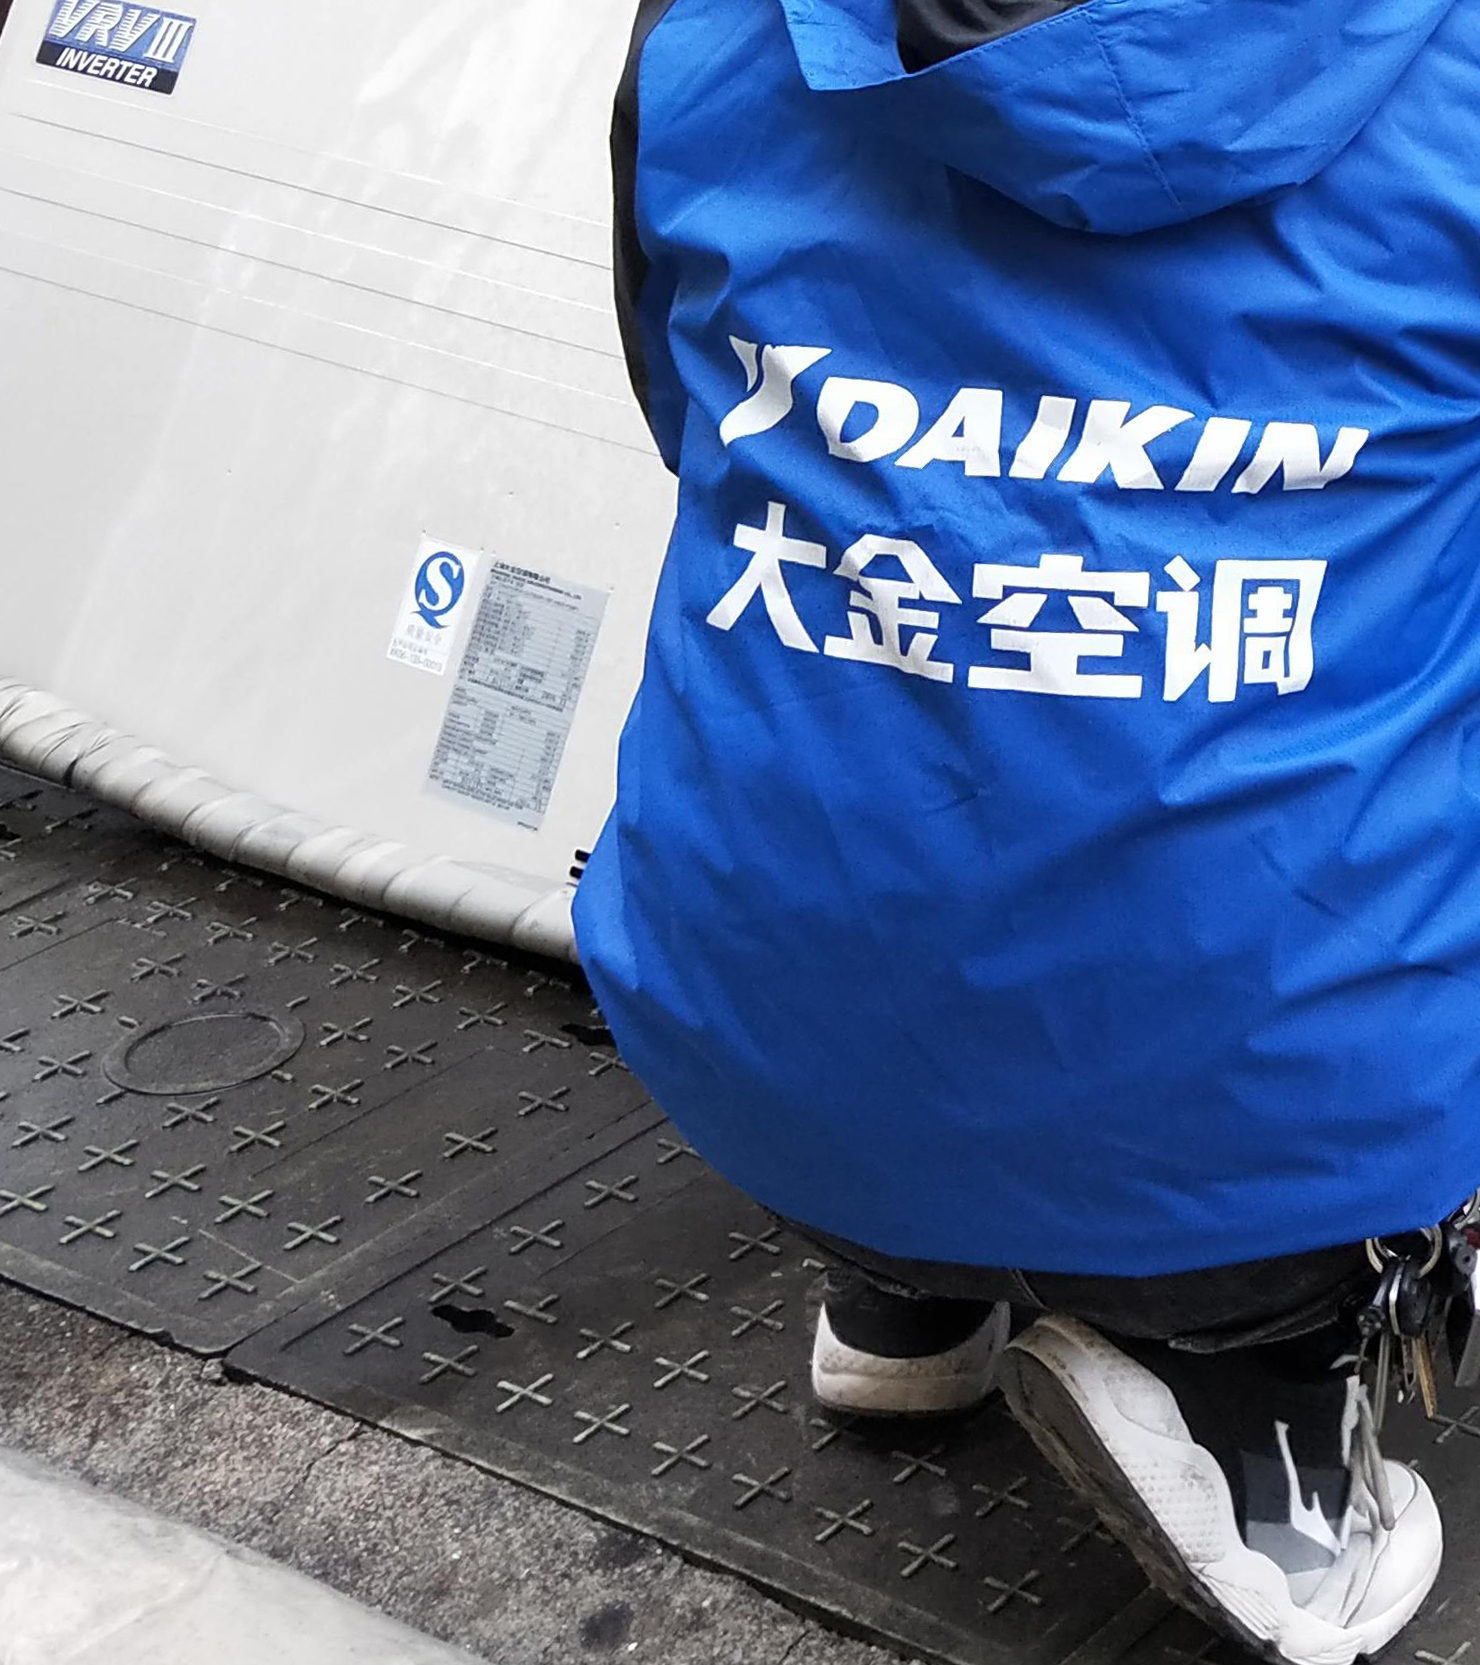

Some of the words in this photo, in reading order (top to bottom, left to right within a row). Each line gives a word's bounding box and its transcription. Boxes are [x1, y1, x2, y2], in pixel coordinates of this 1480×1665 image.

[55, 47, 160, 88] INVERTER
[816, 375, 1370, 495] DAIKIN
[706, 500, 1327, 703] 大金空调
